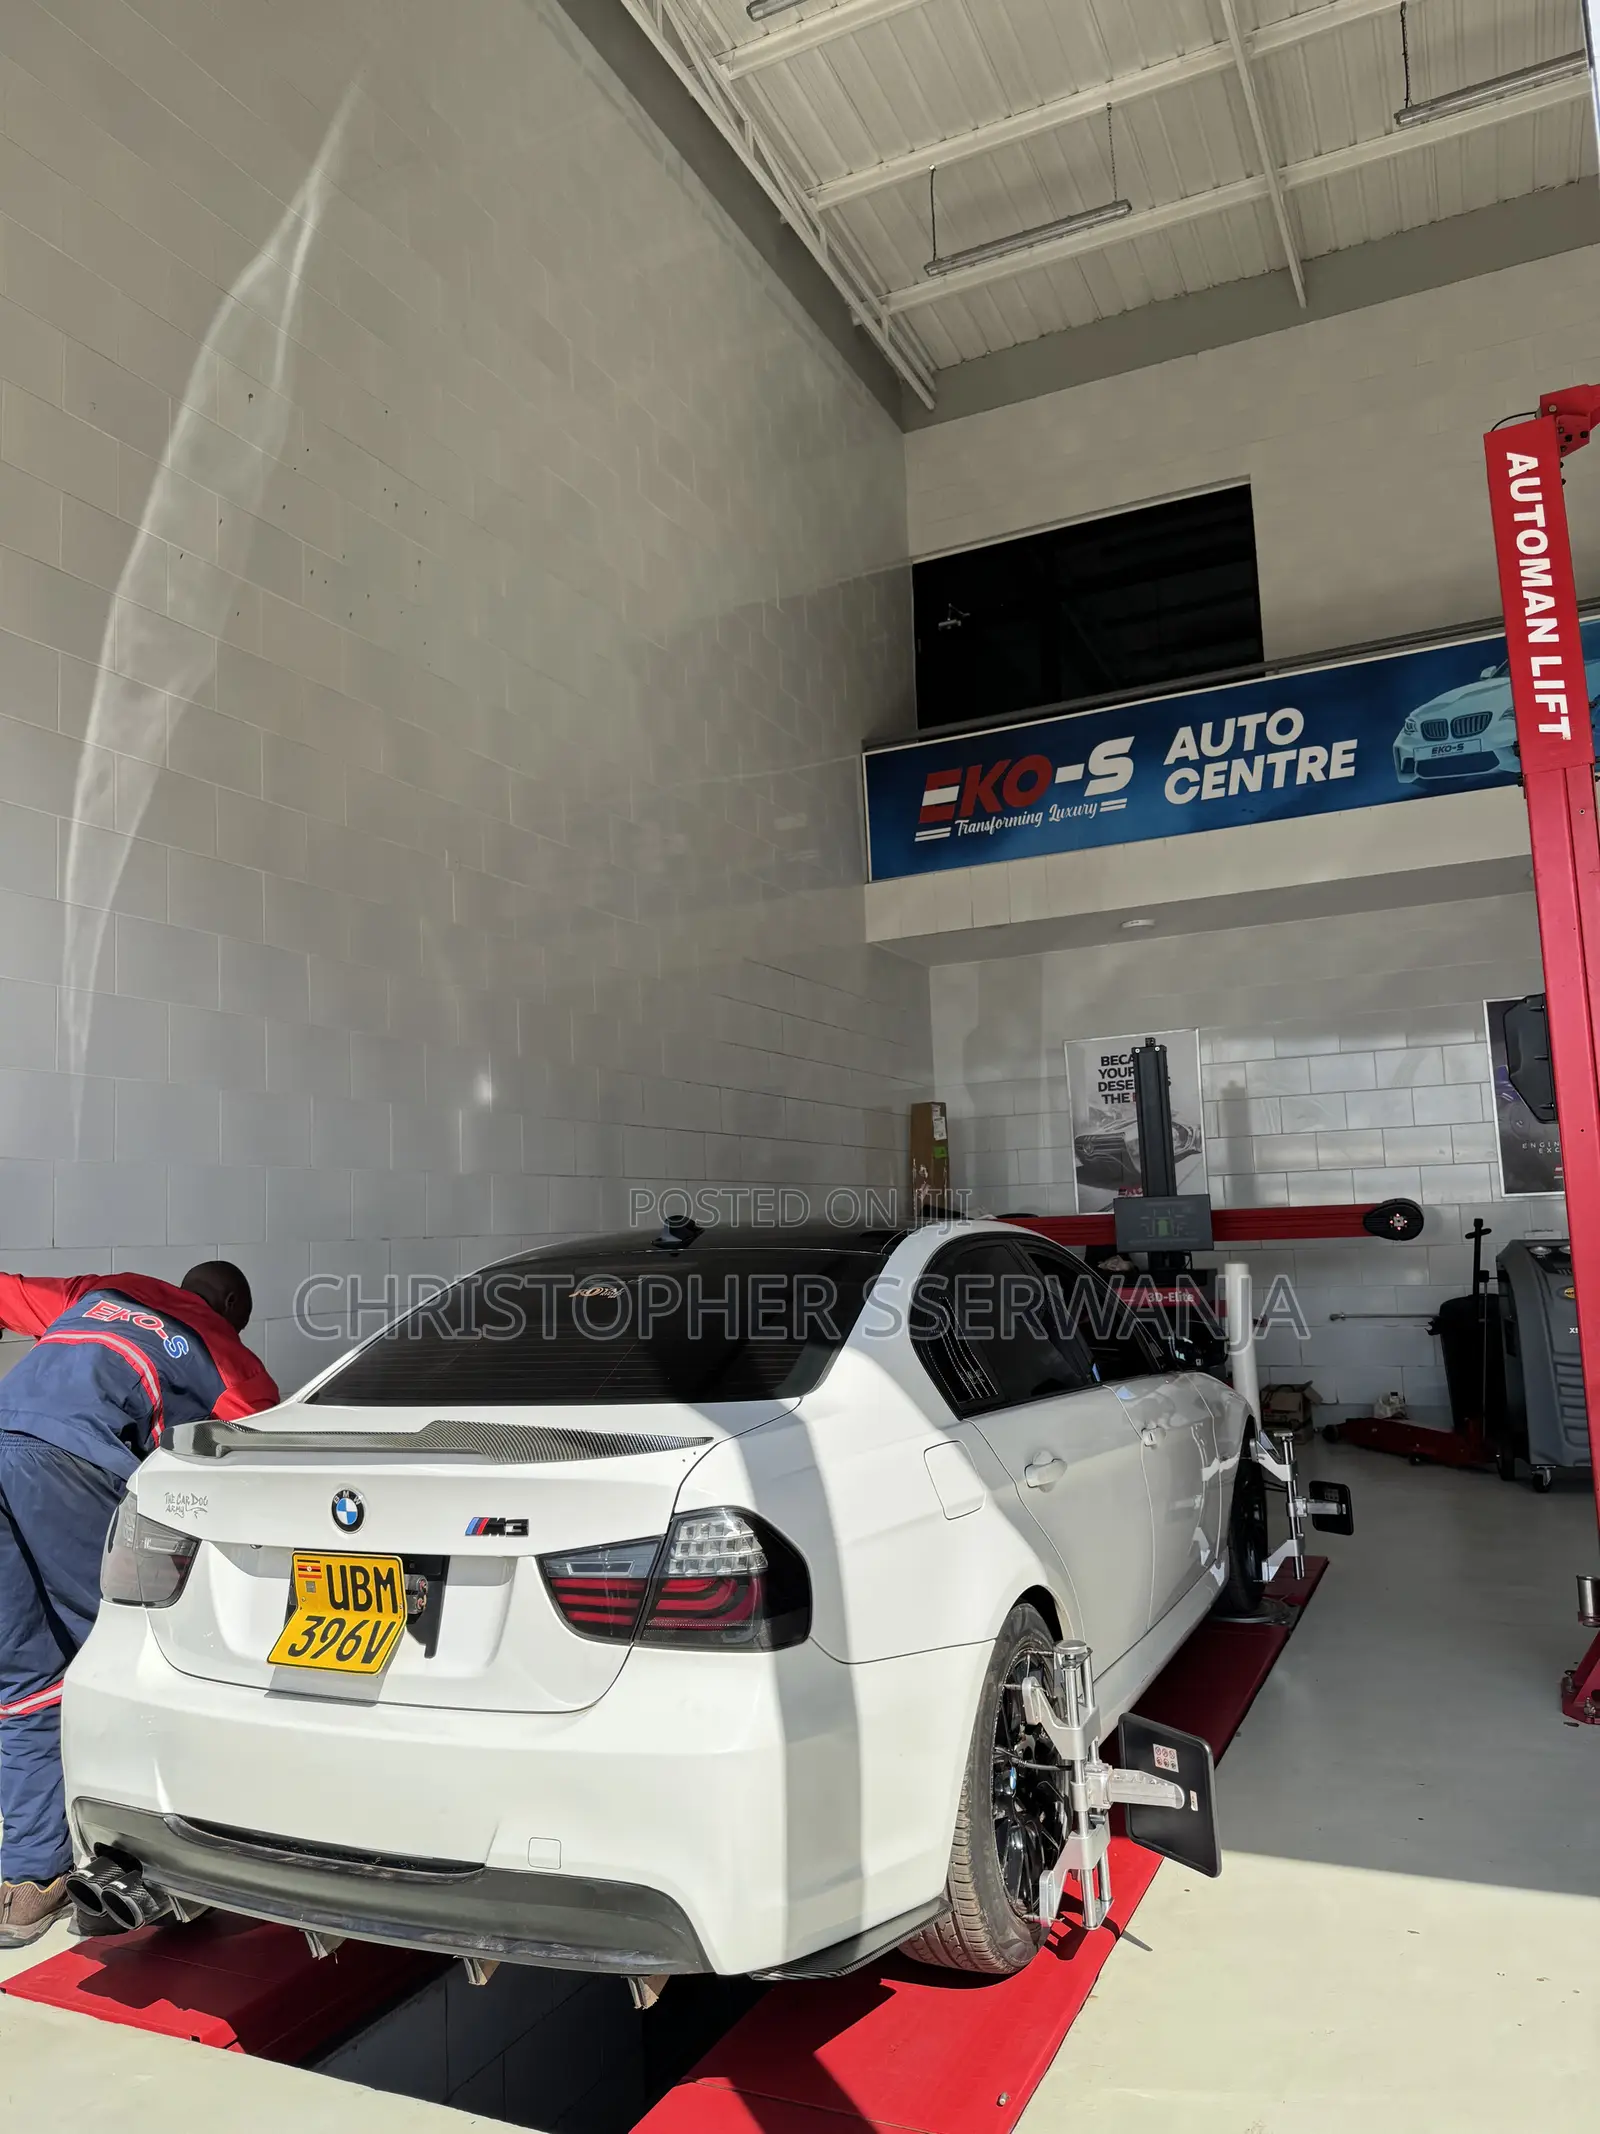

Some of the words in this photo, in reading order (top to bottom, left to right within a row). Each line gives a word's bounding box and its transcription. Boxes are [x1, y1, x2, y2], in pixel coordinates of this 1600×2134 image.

[1506, 452, 1560, 643] AUTOMAN
[1530, 656, 1571, 740] LIFT
[1163, 707, 1304, 765] AUTO
[1432, 743, 1465, 754] EKO-S
[918, 736, 1135, 824] EKO-S
[1164, 739, 1358, 804] CENTRE
[955, 811, 1043, 837] Transforming
[1048, 803, 1098, 822] Luxury
[1101, 1054, 1135, 1067] BECA
[1101, 1093, 1131, 1104] THE
[1522, 1141, 1560, 1150] ENGIN
[1148, 1291, 1194, 1303] 3D-Elite
[82, 1300, 189, 1358] EKO-S
[479, 1517, 529, 1537] M3
[326, 1564, 398, 1613] UBM
[288, 1615, 396, 1664] 396V
